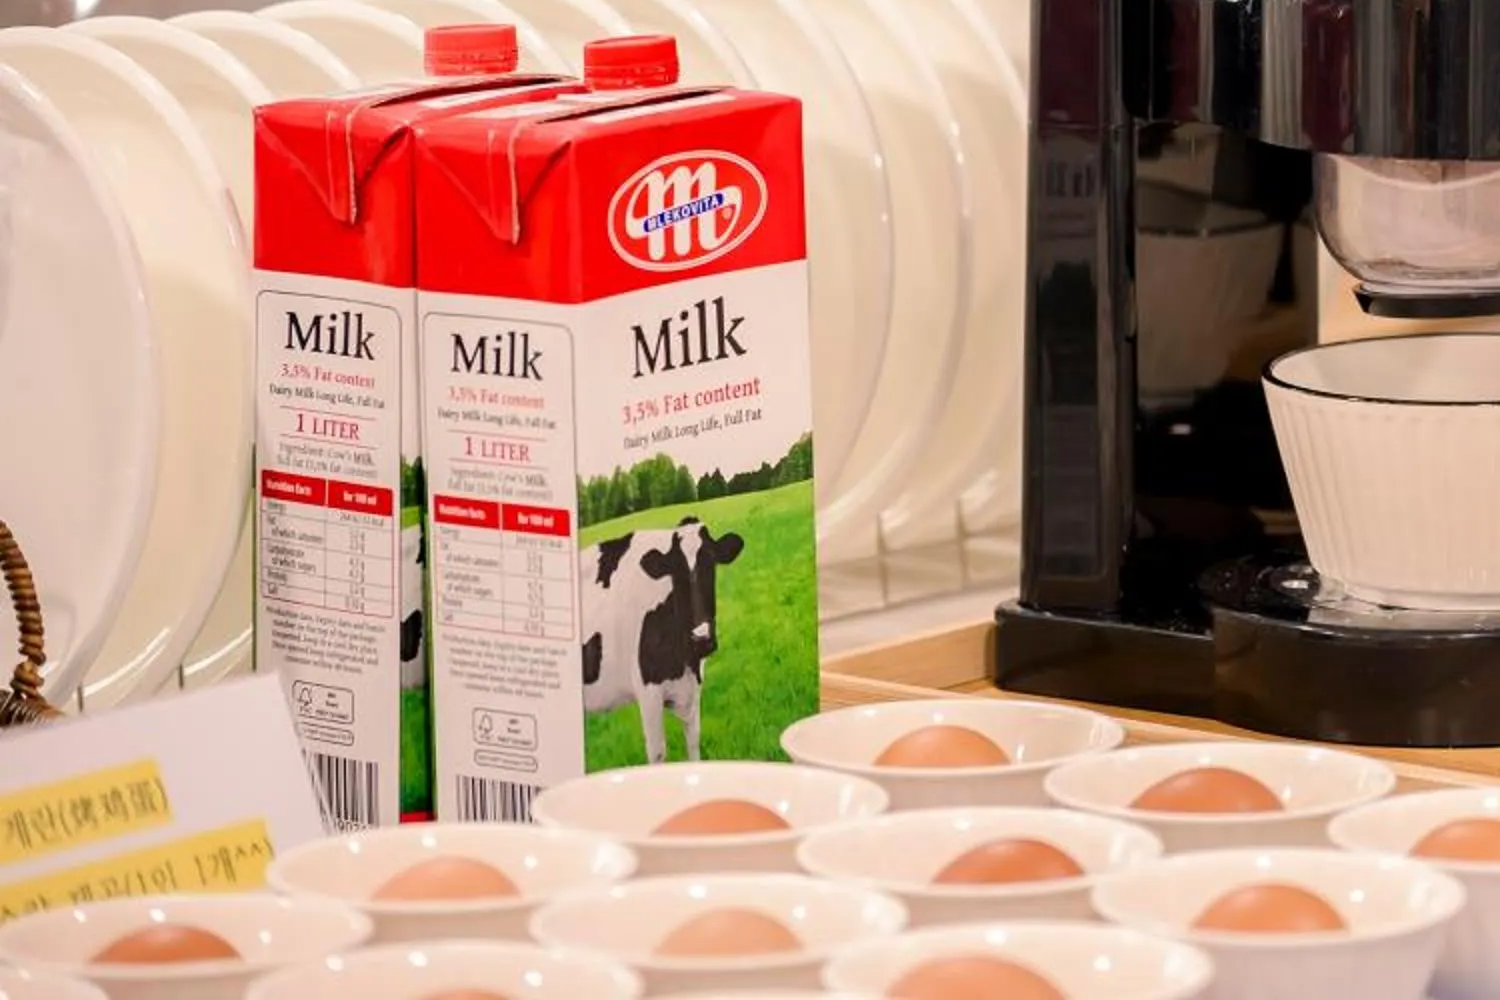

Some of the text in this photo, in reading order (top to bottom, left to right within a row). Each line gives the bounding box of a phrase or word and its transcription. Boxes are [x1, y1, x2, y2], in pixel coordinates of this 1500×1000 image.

[646, 193, 722, 232] MLEKOVITA
[284, 311, 375, 360] Milk
[631, 296, 747, 378] Milk
[450, 331, 543, 381] Milk
[281, 364, 375, 389] 3,5% Fat content
[294, 387, 314, 399] Milk
[480, 388, 498, 404] Fat
[501, 393, 545, 409] content
[622, 377, 761, 427] 3,5% Fat content
[296, 413, 360, 441] 1 LITER
[651, 427, 673, 443] Milk
[675, 422, 699, 439] Long
[700, 416, 723, 431] Life,
[724, 410, 743, 426] Full
[745, 407, 762, 421] Fat
[465, 436, 531, 462] 1 LITER
